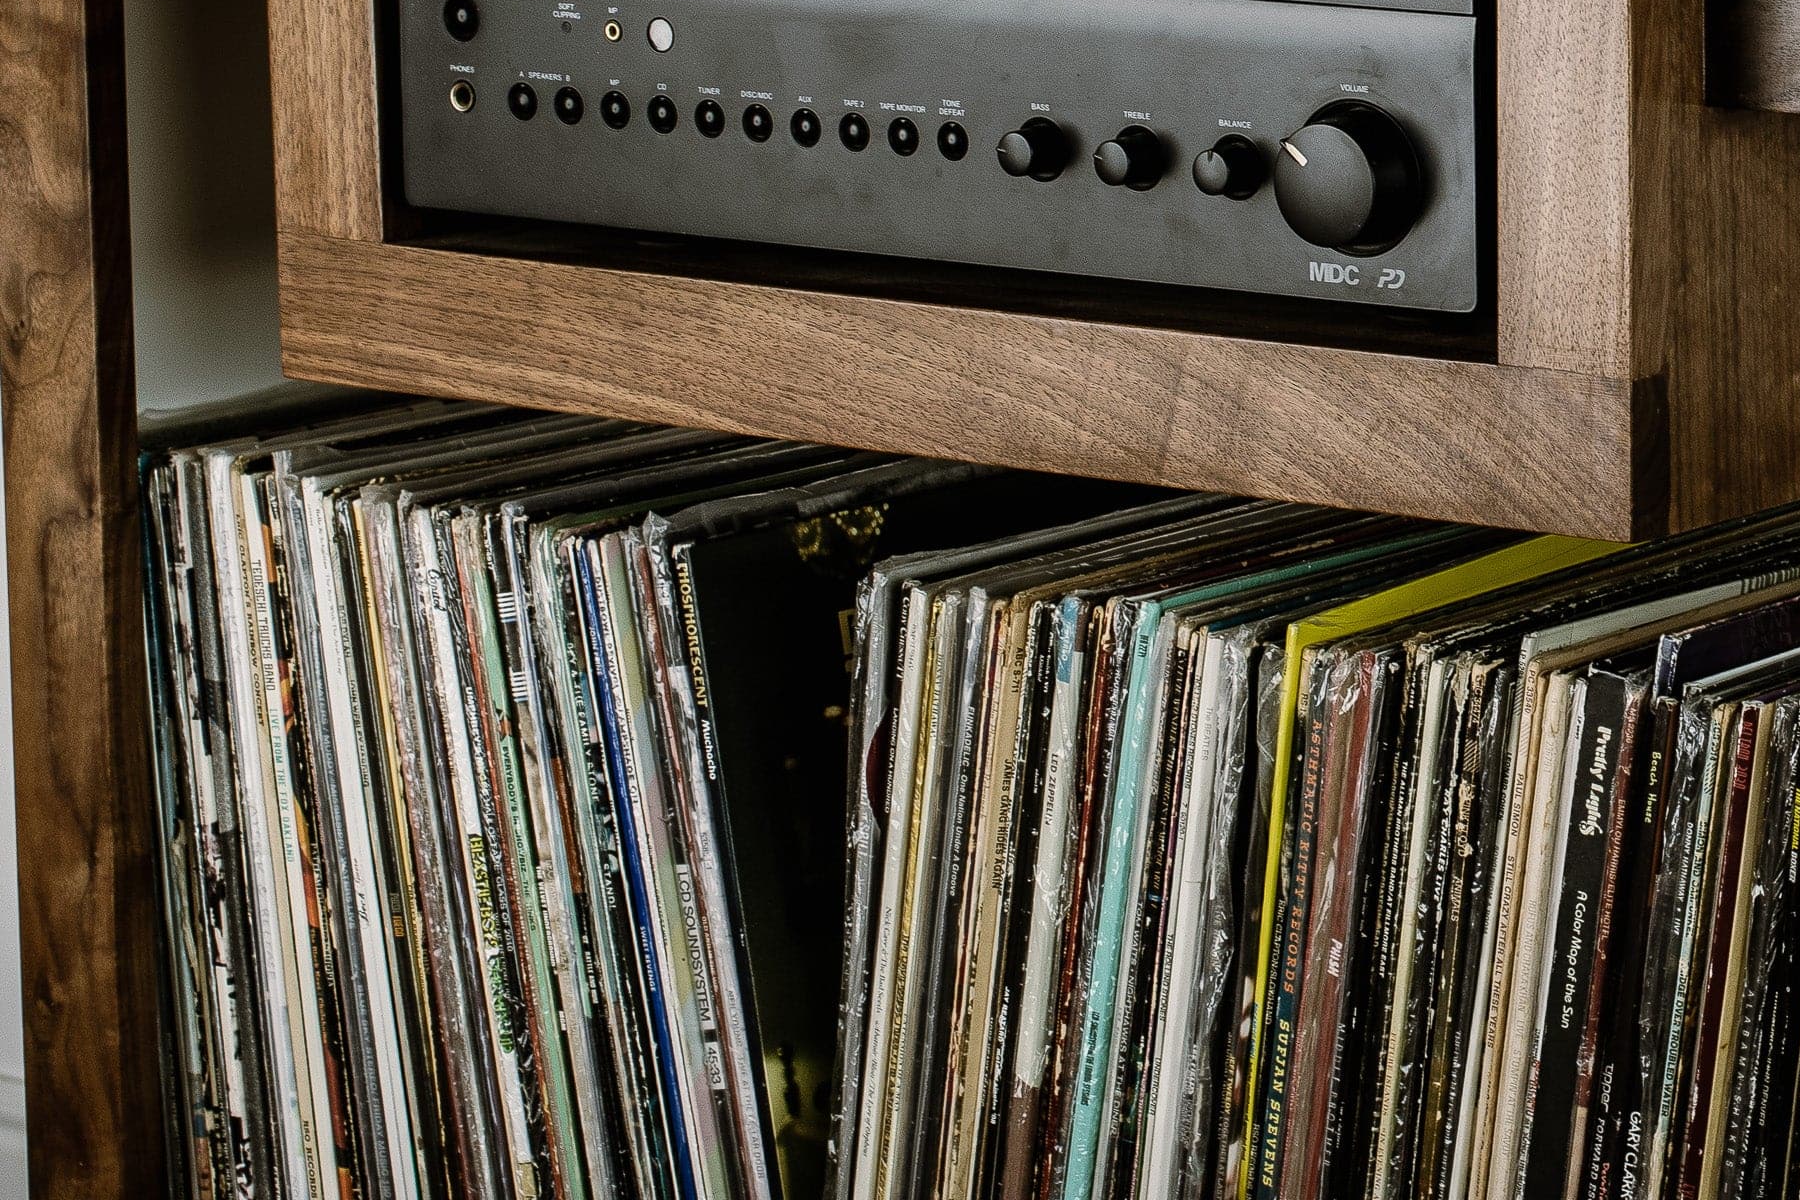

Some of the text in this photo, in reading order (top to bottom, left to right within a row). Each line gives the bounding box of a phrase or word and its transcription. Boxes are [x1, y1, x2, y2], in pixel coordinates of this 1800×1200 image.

[552, 10, 581, 20] CLIPPING
[450, 64, 474, 74] PHONES
[528, 72, 562, 82] SPEAKERS
[656, 83, 666, 91] CD
[698, 86, 720, 96] TUNER
[1340, 84, 1369, 94] VOLUME
[844, 99, 864, 108] TAPE 2
[879, 102, 926, 114] TAPE MONITOR
[938, 107, 965, 117] DEFEAT
[942, 100, 961, 108] TONE
[1030, 102, 1050, 112] BASS
[1123, 110, 1151, 120] TREBLE
[1218, 118, 1252, 130] BALANCE
[1310, 261, 1360, 286] MDC
[251, 560, 265, 614] TEDESCHI
[257, 617, 270, 660] TRUCKS
[675, 561, 709, 708] PHOSPHORESCENT
[1013, 646, 1023, 667] ABC
[262, 663, 274, 691] BAND
[269, 708, 279, 732] LIVE
[1199, 706, 1214, 761] The BEATLES
[272, 735, 282, 764] FROM
[960, 705, 974, 766] FUNKADELIC
[275, 766, 286, 788] THE
[958, 774, 968, 792] One
[1000, 759, 1012, 792] JAMES
[1043, 753, 1058, 826] LED ZEPPELIN
[1643, 751, 1662, 824] Beach House
[278, 791, 289, 812] FOX
[955, 794, 966, 823] Nation
[997, 794, 1009, 824] GANG
[952, 825, 962, 853] Under
[994, 826, 1006, 856] RIDES
[1486, 669, 1536, 1048] PC 33540 PAUL SIMON STILL CRAZY AFTER ALL THESE YEARS
[1786, 851, 1798, 882] BOXER
[676, 871, 692, 902] LCD
[948, 862, 959, 896] Groove
[990, 858, 1002, 890] AGAIN
[1560, 725, 1612, 1029] Pretty Lights A Color Map of the Sun
[681, 904, 712, 1022] SOUNDSYSTEM
[1260, 719, 1323, 1187] ASTHMATIC KITTY RECORDS SUFJAN STEVENS
[1326, 938, 1342, 977] PHISH
[1108, 901, 1143, 1135] TOM WAITS NIGHTHAWKS AT THE DINER
[1659, 1000, 1683, 1117] OVER TROUBLED WATER
[1625, 1111, 1642, 1151] GARY
